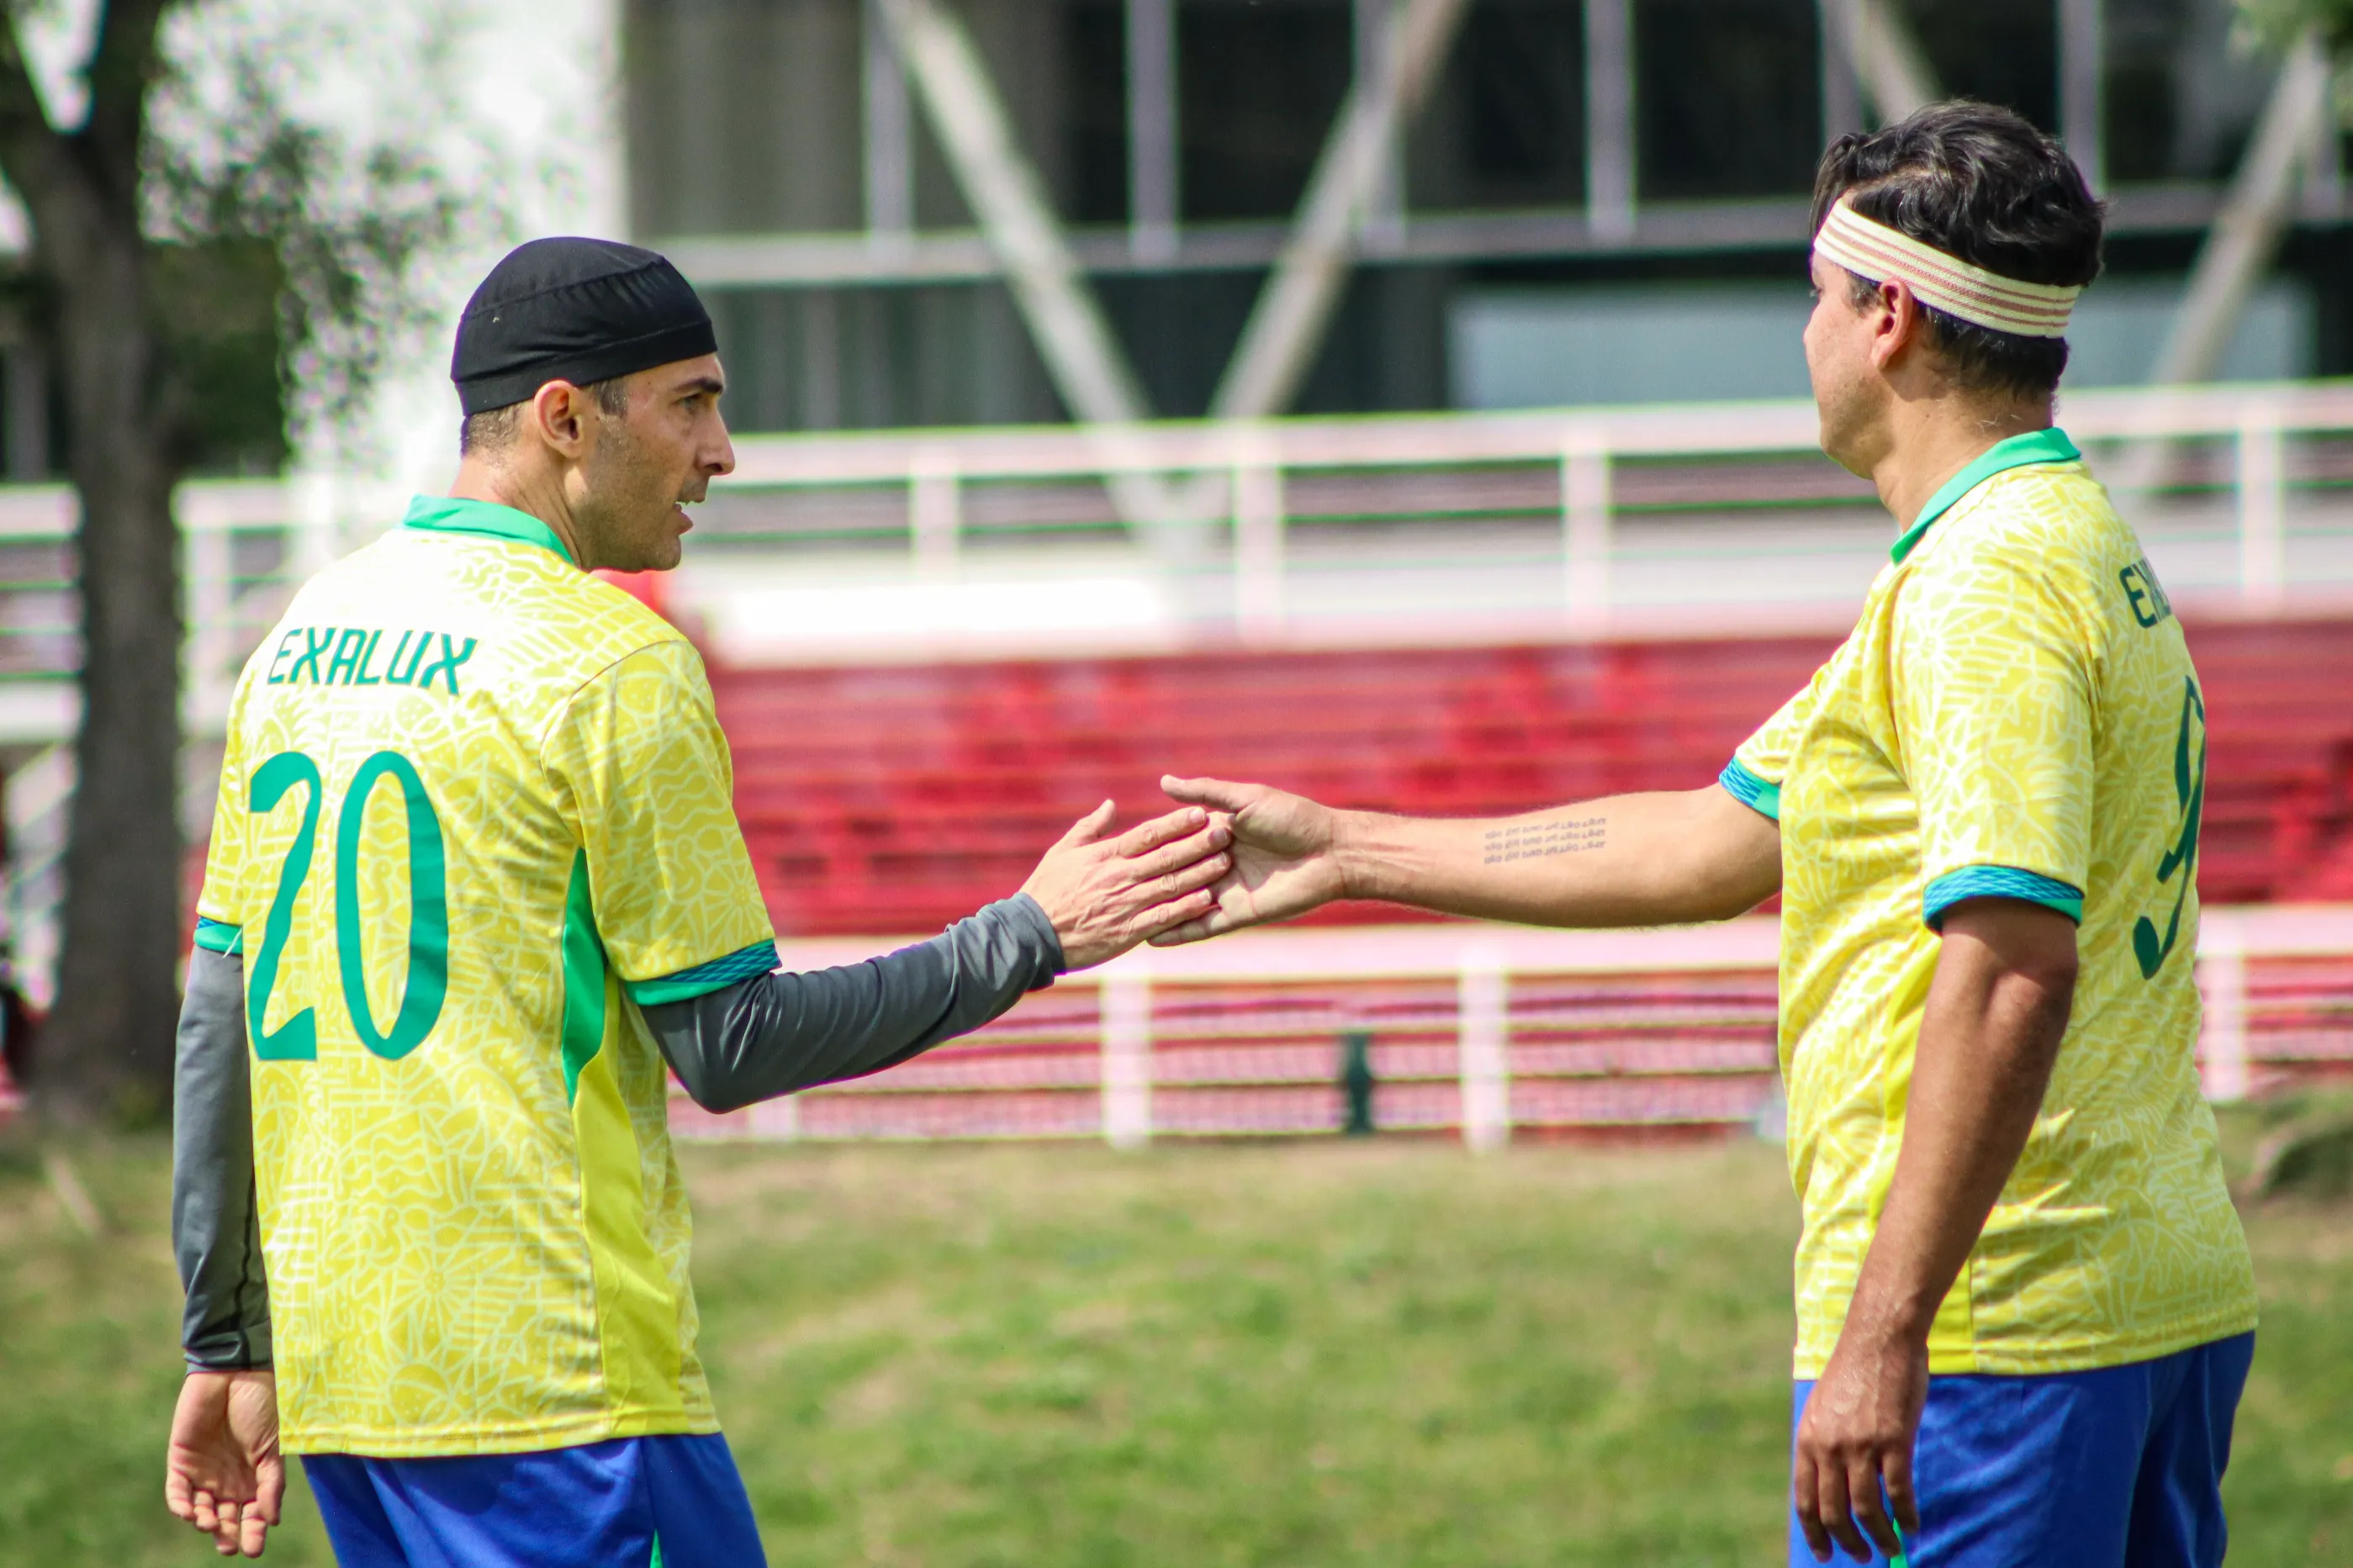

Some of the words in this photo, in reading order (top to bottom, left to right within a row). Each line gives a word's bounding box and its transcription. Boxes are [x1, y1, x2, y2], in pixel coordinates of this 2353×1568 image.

[267, 626, 478, 697] EXALUX
[248, 750, 449, 1061] 20
[2133, 674, 2206, 981] 9
